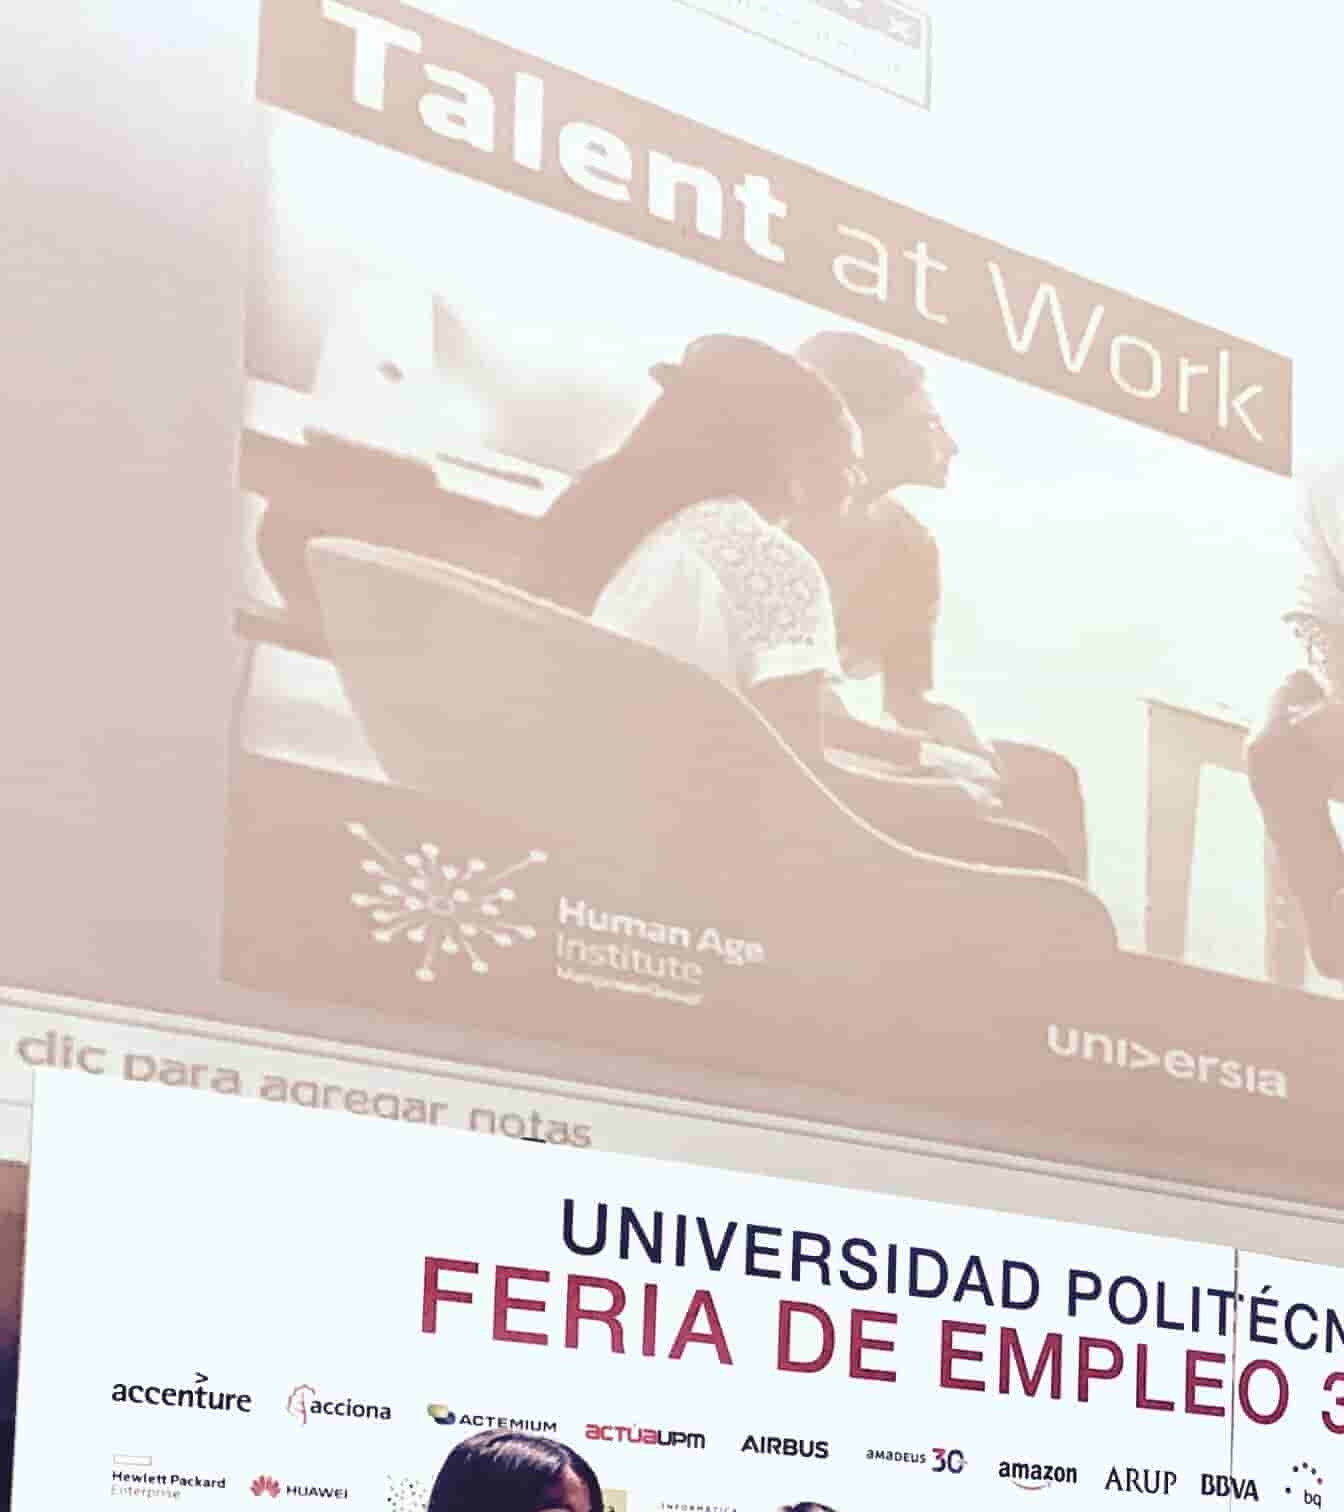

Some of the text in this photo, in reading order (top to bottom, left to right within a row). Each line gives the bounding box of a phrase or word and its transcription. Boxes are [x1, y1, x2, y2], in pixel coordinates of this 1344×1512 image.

[321, 0, 1264, 442] Talent at Work
[558, 895, 766, 967] Human Age
[555, 931, 704, 985] Institute
[468, 1104, 593, 1148] notas
[562, 1198, 1040, 1311] UNIVERSIDAD
[421, 1255, 734, 1366] FERIA
[776, 1299, 898, 1383] DE
[939, 1319, 1290, 1425] EMPLEO
[111, 1379, 252, 1413] accenture
[309, 1398, 392, 1421] acciona
[458, 1413, 557, 1433] ACTEMIUM
[741, 1434, 830, 1460] AIRBUS
[112, 1471, 226, 1489] Hewlett Packard
[998, 1460, 1078, 1484] amazon
[1104, 1464, 1178, 1495] ARUP
[1200, 1472, 1260, 1502] BBVA
[285, 1485, 348, 1500] HUAWEI
[1304, 1488, 1322, 1508] bq
